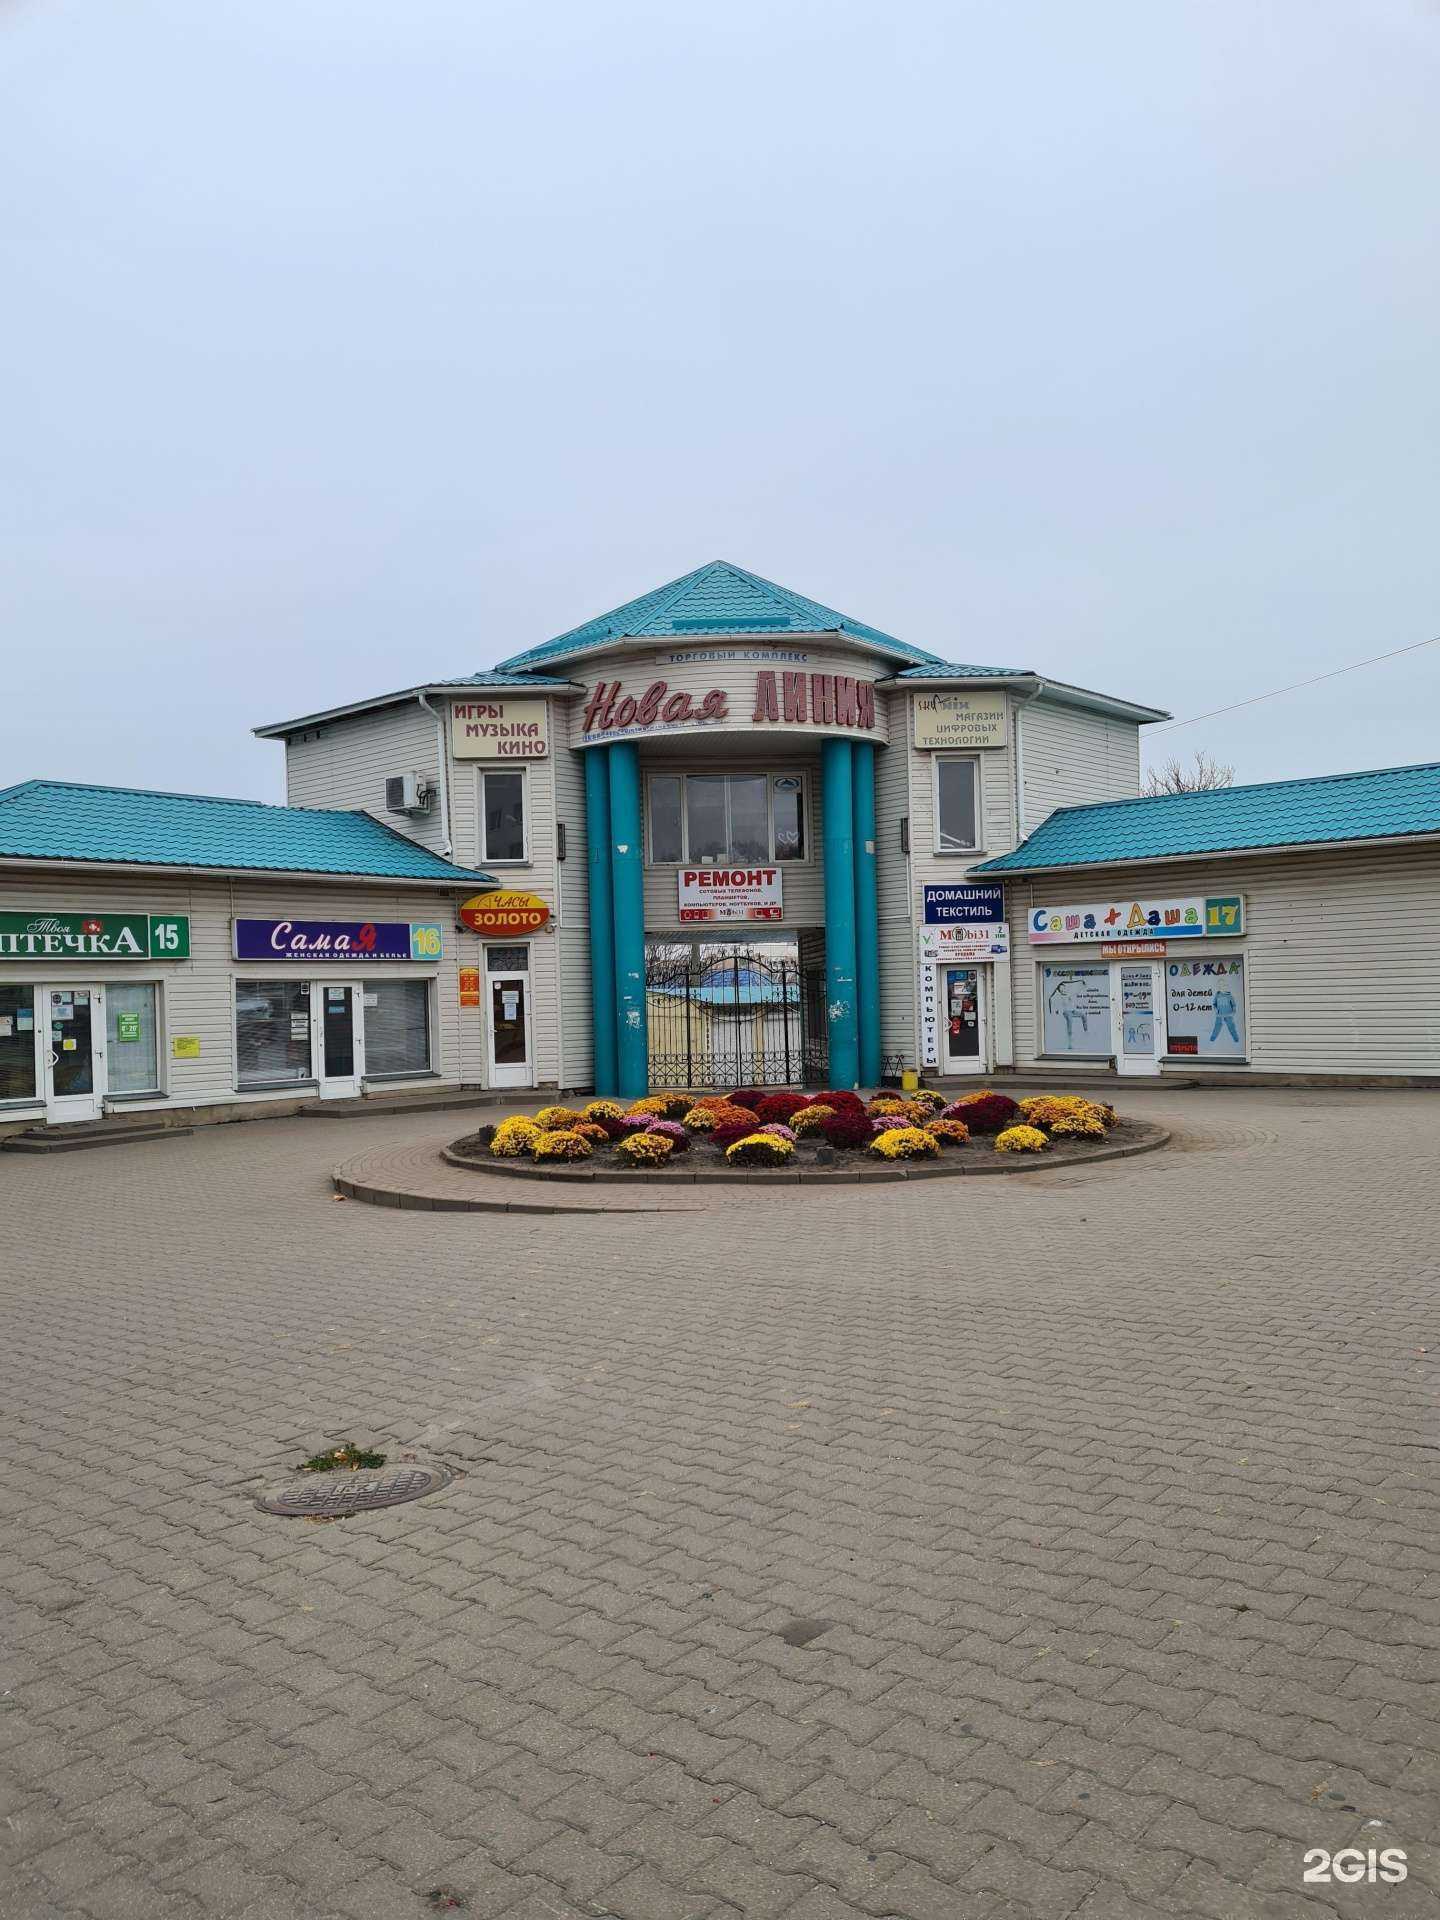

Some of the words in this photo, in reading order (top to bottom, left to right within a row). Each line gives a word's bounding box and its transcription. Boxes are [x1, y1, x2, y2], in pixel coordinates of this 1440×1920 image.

[743, 650, 808, 662] КОМПЛЕКС
[582, 680, 729, 732] Новая
[752, 670, 876, 729] ЛИНИЯ
[454, 704, 504, 720] ИГРЫ
[955, 712, 1004, 722] МАГАЗИН
[465, 722, 539, 738] МУЗЫКА
[936, 723, 998, 733] ЦИФРОВЫХ
[497, 740, 546, 755] КИНО
[922, 735, 990, 746] ТЕХНОЛОГИИ
[684, 869, 777, 887] РЕМОНТ
[494, 895, 530, 908] ЧАСЫ
[927, 887, 1001, 903] ДОМАШНИЙ
[473, 912, 542, 925] ЗОЛОТО
[935, 906, 993, 917] ТЕКСТИЛЬ
[1033, 908, 1097, 932] Саша
[1126, 902, 1199, 928] Даша
[1207, 904, 1240, 926] 17
[26, 918, 72, 934] Твоя
[0, 926, 144, 953] ПТЕЧКА
[154, 923, 179, 950] 15
[413, 927, 441, 955] 16
[1073, 930, 1111, 940] ДЕТСКАЯ
[1117, 928, 1154, 938] ОДЕЖДА
[1102, 943, 1117, 955] МЫ
[1169, 962, 1240, 977] ОДЕЖДА
[1170, 988, 1186, 998] для
[1187, 988, 1213, 997] детей
[924, 965, 936, 1064] КОМПЬЮТЕРЫ
[1173, 1002, 1197, 1012] 0-12
